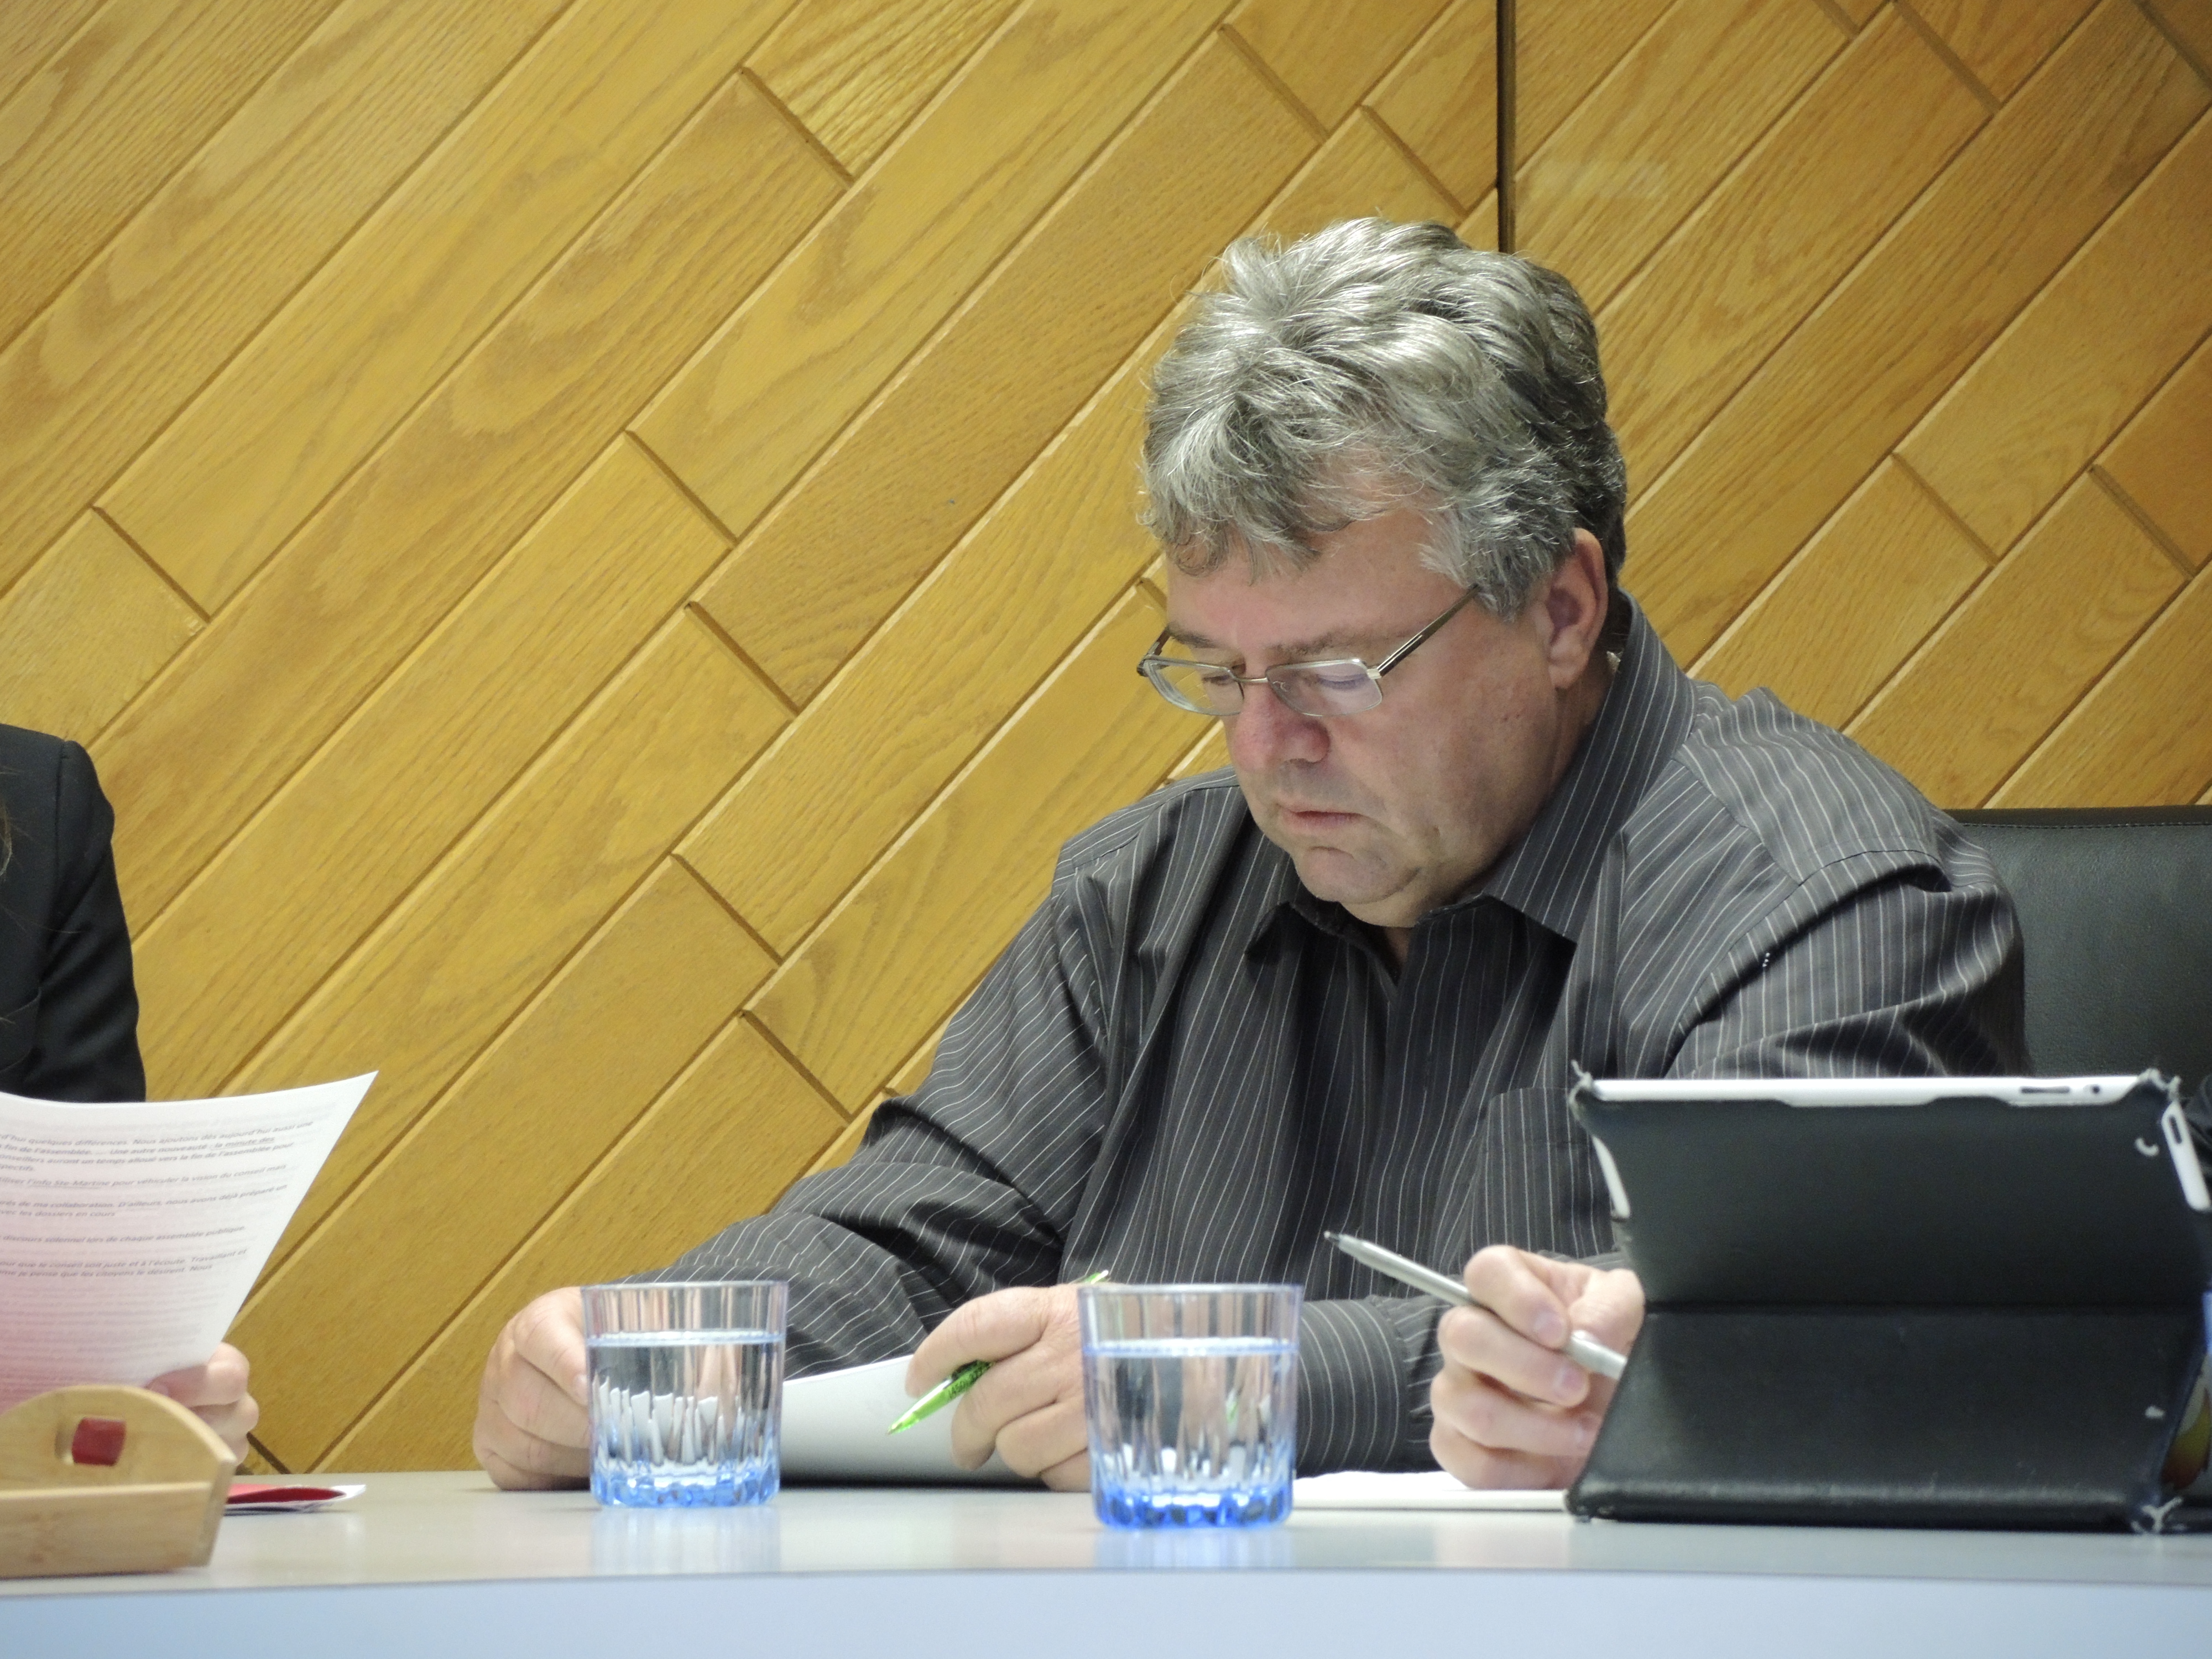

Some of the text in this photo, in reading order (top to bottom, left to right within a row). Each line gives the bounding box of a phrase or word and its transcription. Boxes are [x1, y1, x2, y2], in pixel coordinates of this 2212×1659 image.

[219, 1128, 272, 1139] aujourd'hui
[273, 1124, 296, 1133] aussi
[218, 1146, 271, 1156] l'assemblée
[272, 1142, 294, 1151] pour
[233, 1166, 267, 1177] conseil
[239, 1186, 275, 1199] préparé
